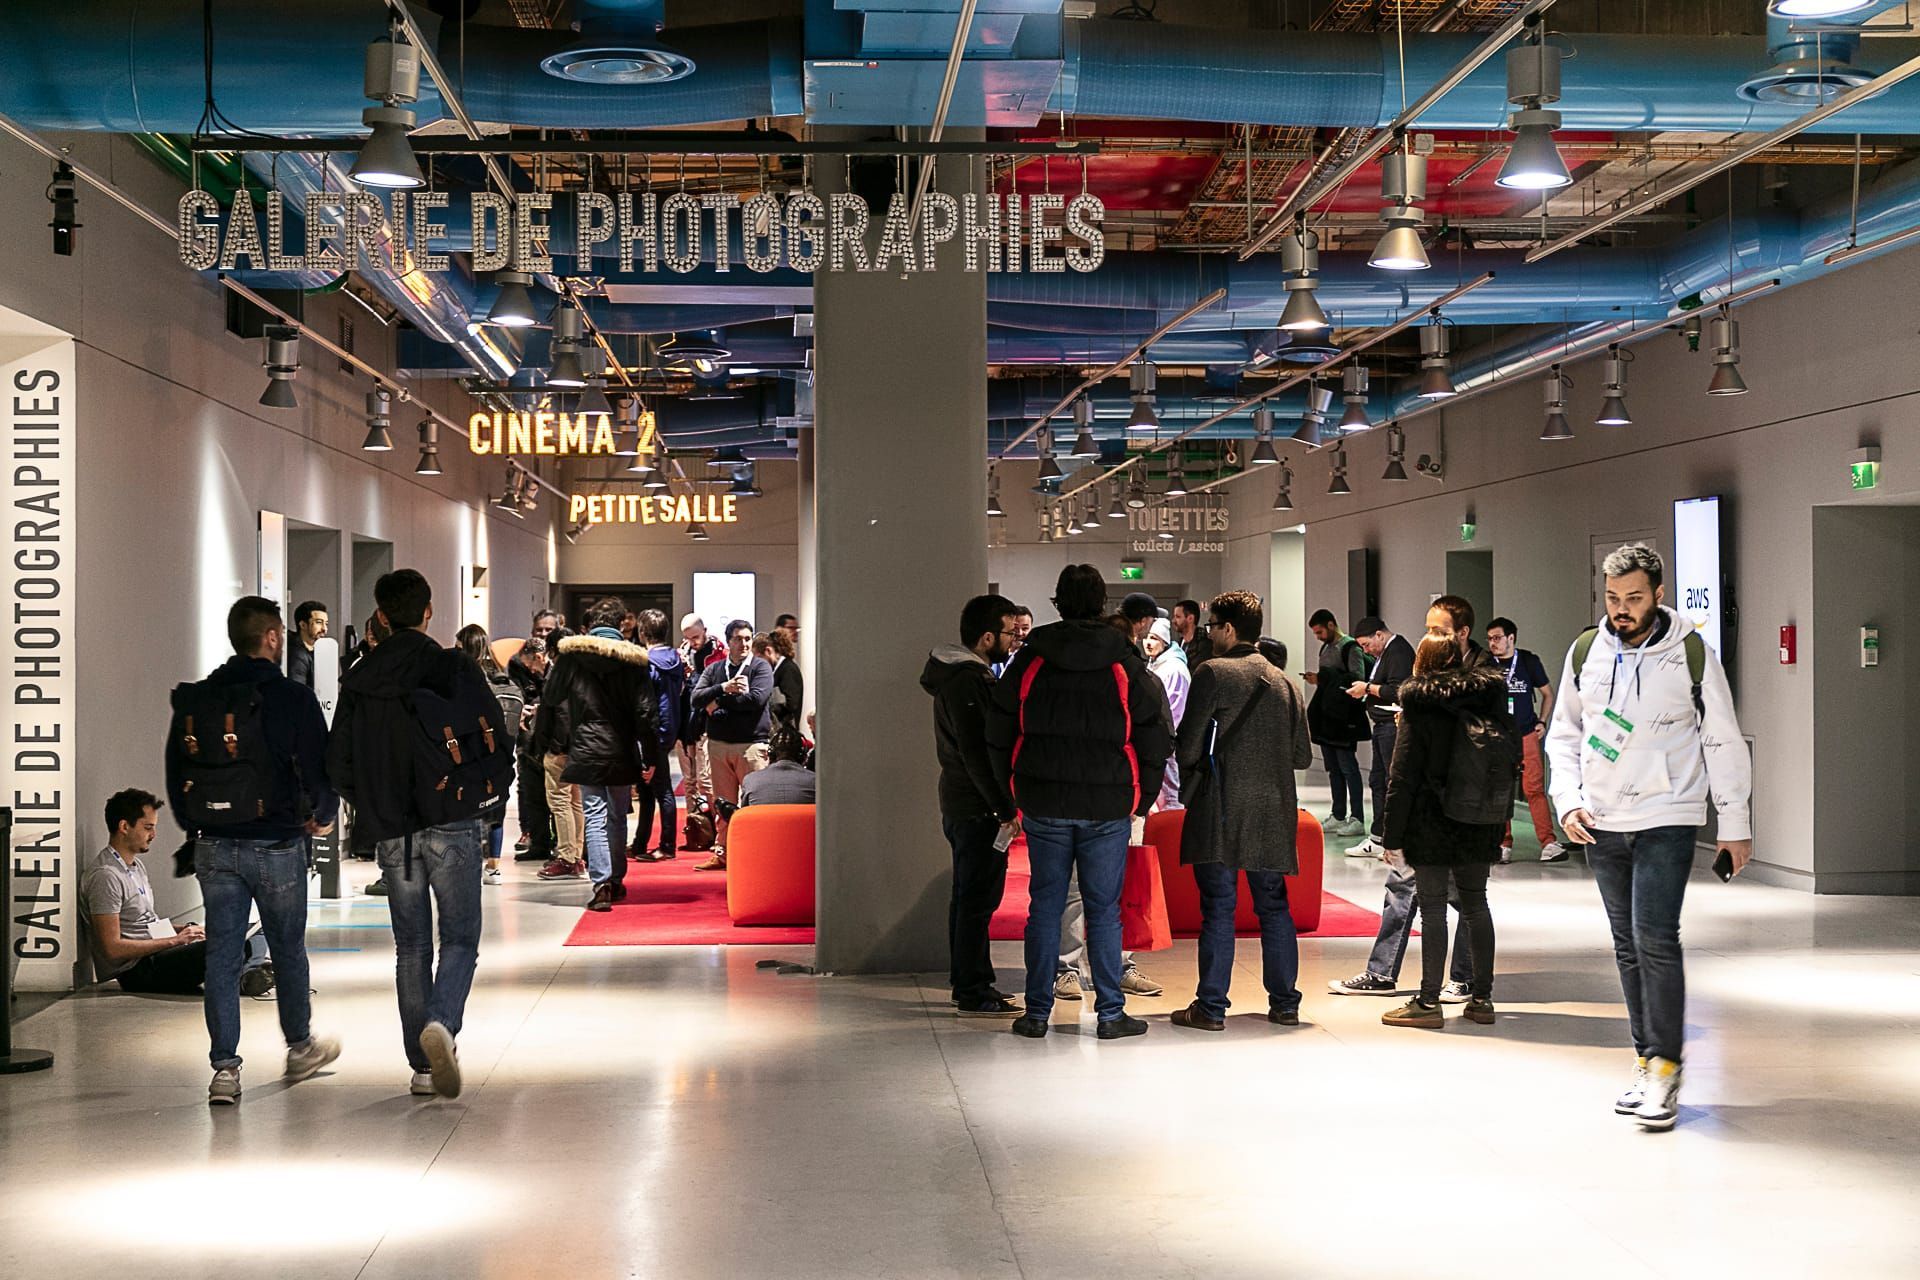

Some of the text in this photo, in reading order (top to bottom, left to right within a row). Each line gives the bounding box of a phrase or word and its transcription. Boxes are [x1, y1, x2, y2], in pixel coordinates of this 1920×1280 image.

[177, 190, 1106, 273] GALERIE DE PHOTOGRAPHIES
[469, 400, 656, 454] CINÉMA 2
[569, 494, 737, 525] PETITE SALLE
[1126, 506, 1230, 531] TOILETTES
[14, 369, 60, 705] PHOTOGRAPHIES
[1132, 540, 1174, 552] toilets
[1188, 542, 1225, 552] aseos
[1686, 587, 1710, 609] aws
[14, 723, 60, 771] DE
